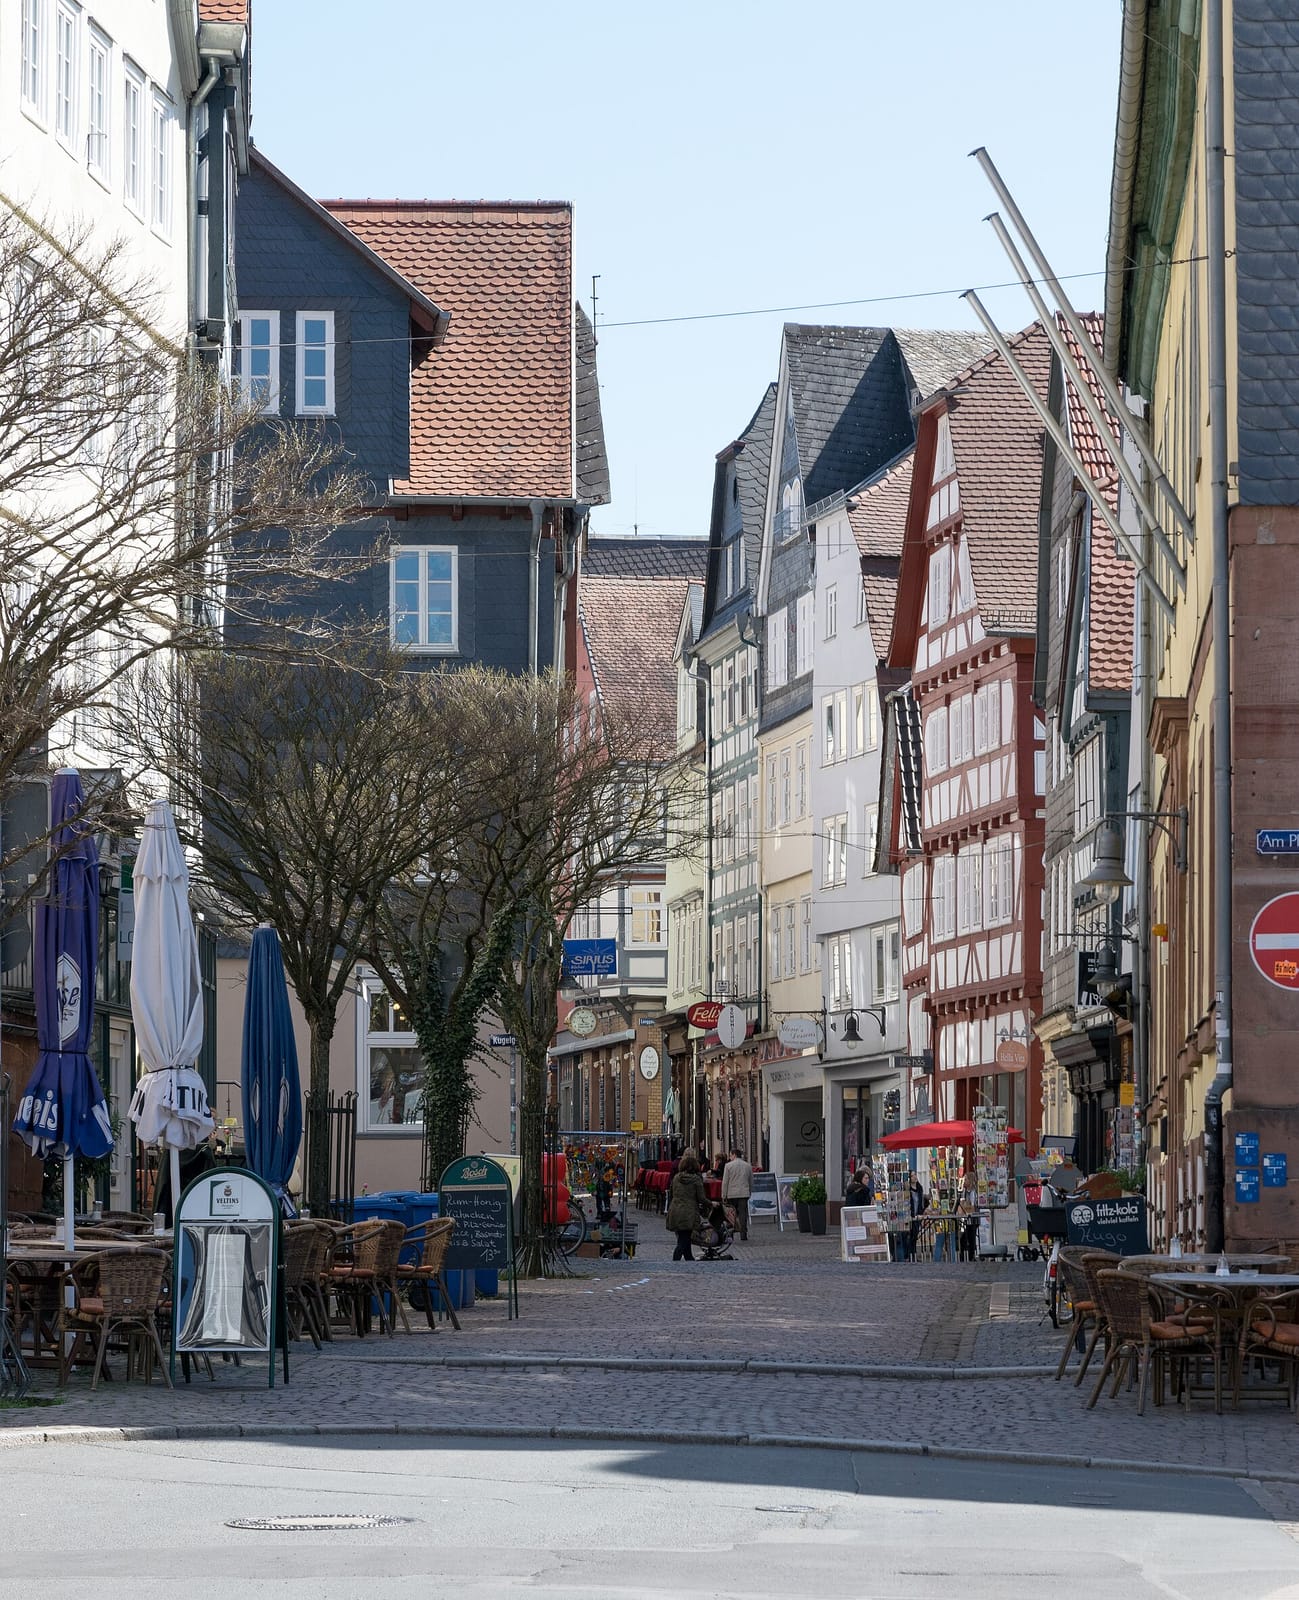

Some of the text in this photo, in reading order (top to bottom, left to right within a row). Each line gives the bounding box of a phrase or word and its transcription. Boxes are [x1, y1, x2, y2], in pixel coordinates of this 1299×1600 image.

[1262, 833, 1284, 848] Am
[570, 954, 614, 967] SIRIUS
[461, 1165, 488, 1179] Bosch
[1096, 1202, 1138, 1217] fritz-kola
[1077, 1226, 1127, 1247] Hugo
